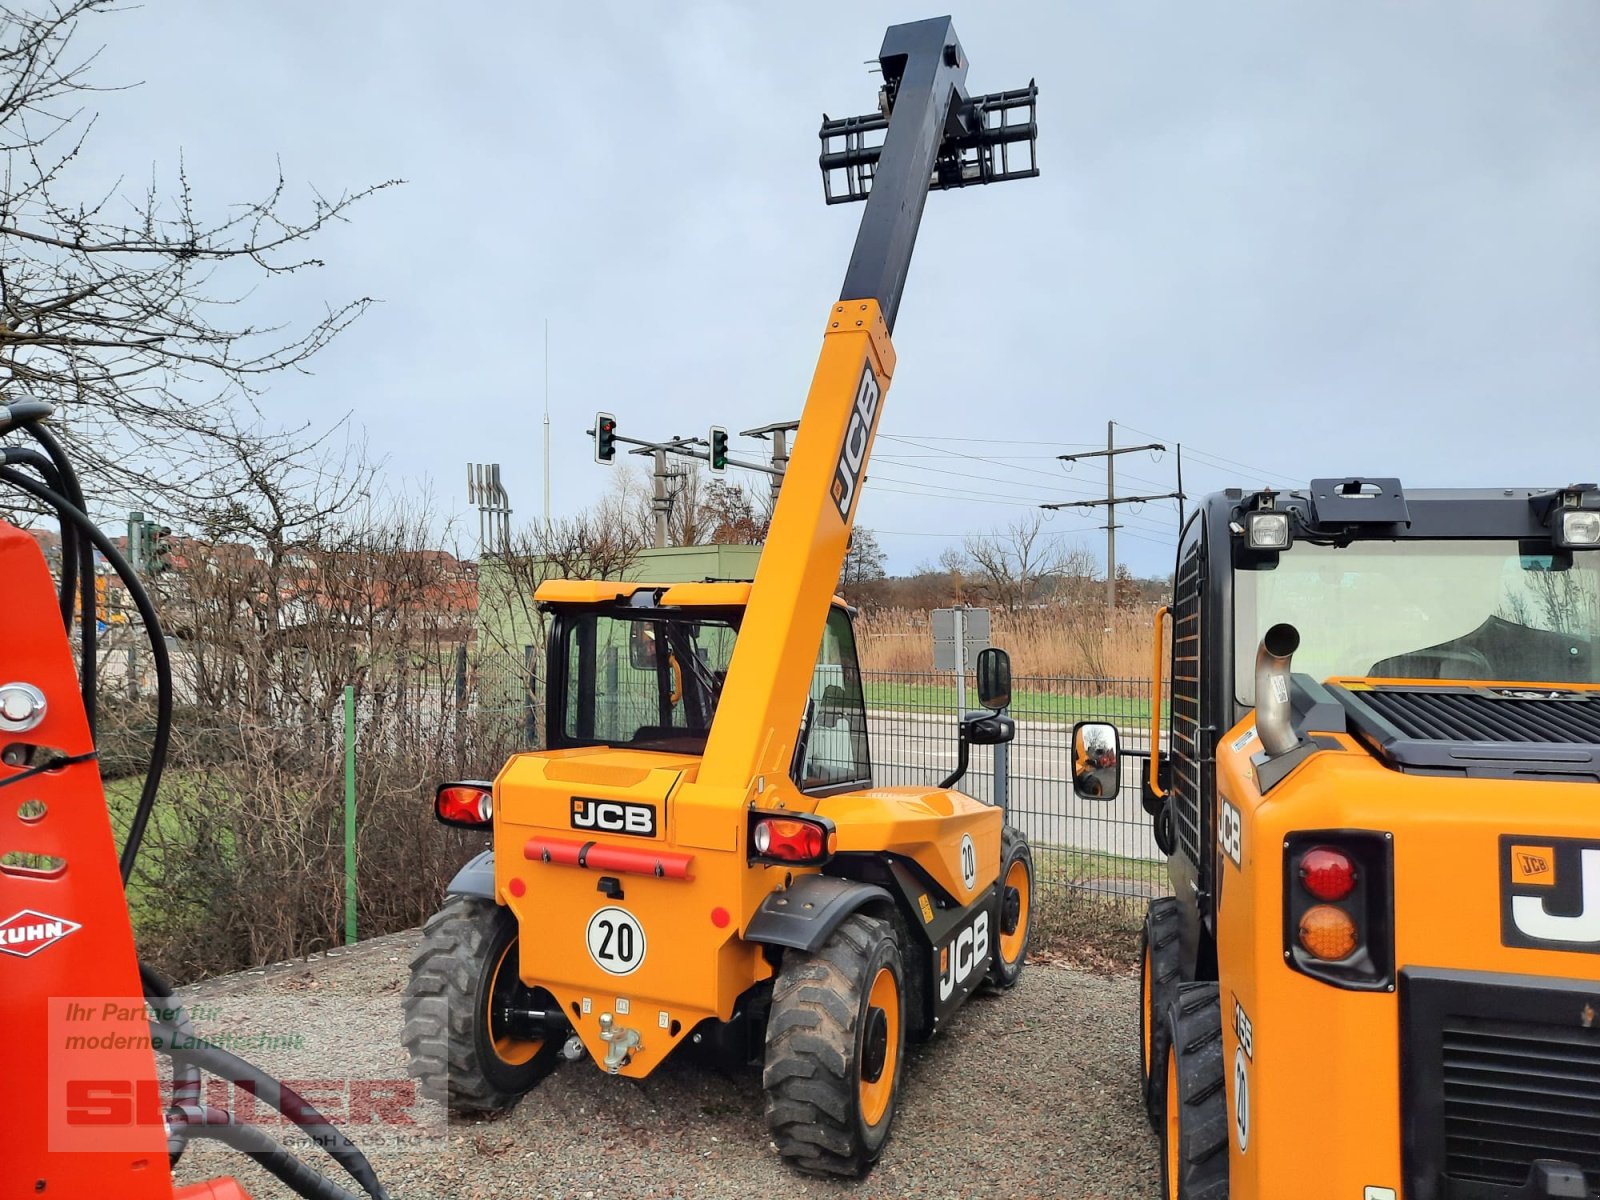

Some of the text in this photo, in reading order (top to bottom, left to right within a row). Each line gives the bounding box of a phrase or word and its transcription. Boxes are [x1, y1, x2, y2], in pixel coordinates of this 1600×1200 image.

[839, 368, 881, 515] JCB
[574, 802, 653, 832] JCB
[1218, 798, 1241, 865] JCB
[961, 844, 974, 880] 20
[1522, 855, 1548, 874] JCB
[598, 919, 635, 963] 20
[939, 910, 989, 1001] JCB
[1237, 1062, 1246, 1137] 20
